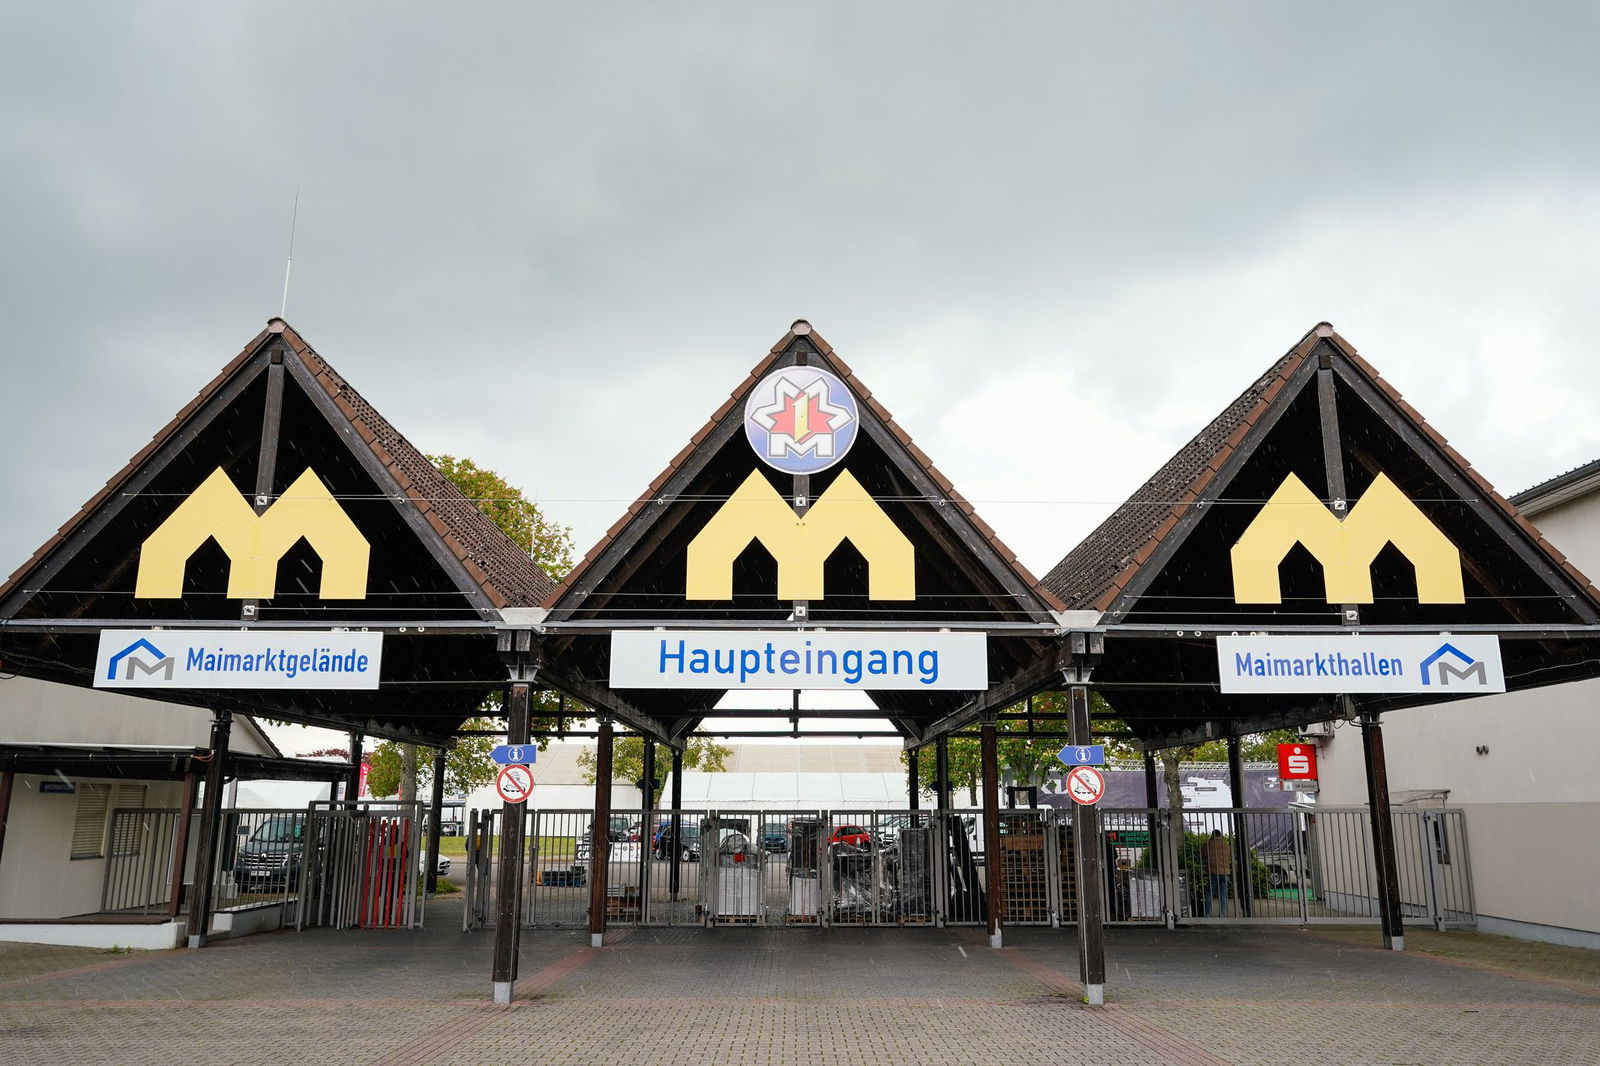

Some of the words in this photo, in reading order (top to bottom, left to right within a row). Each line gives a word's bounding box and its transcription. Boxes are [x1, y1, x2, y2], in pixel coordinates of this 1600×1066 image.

[186, 647, 369, 678] Maimarktgelände
[659, 640, 939, 685] Haupteingang
[1235, 652, 1403, 676] Maimarkthallen
